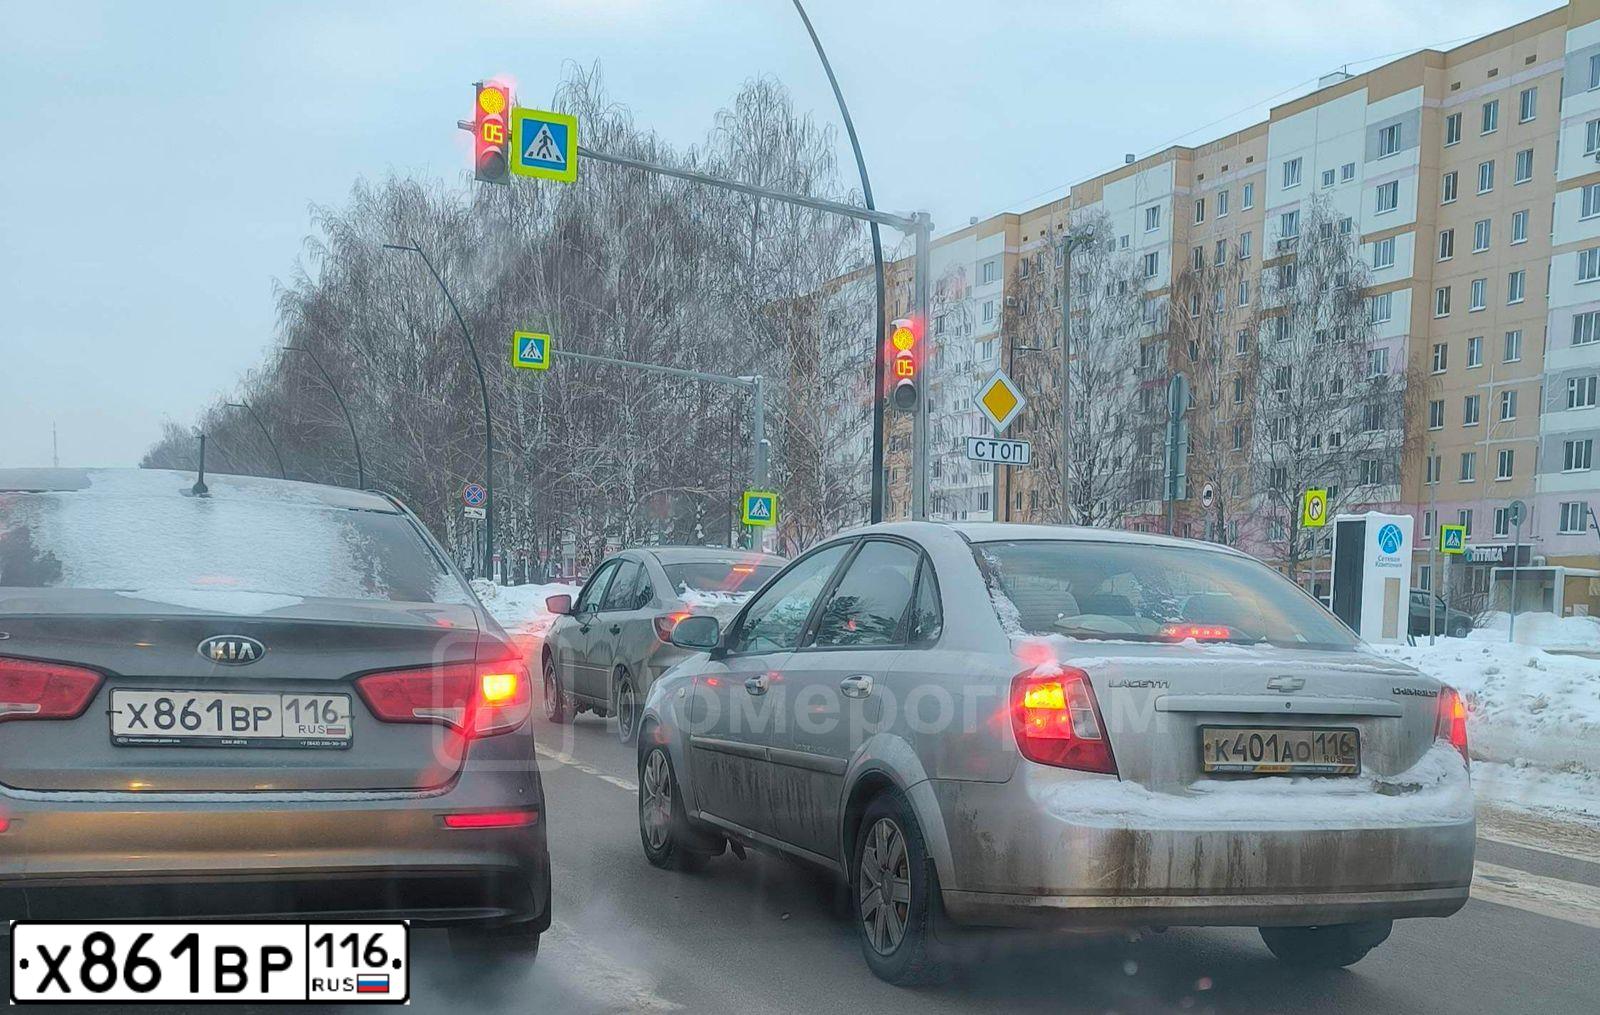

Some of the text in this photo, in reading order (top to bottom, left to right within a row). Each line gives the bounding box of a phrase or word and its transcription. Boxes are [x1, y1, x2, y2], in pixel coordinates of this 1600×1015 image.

[484, 123, 503, 144] 05
[898, 359, 913, 376] 05
[975, 441, 1023, 461] СТОП
[209, 641, 255, 660] KIA
[285, 698, 338, 723] 116
[298, 724, 326, 734] RUS
[1315, 733, 1351, 755] 116
